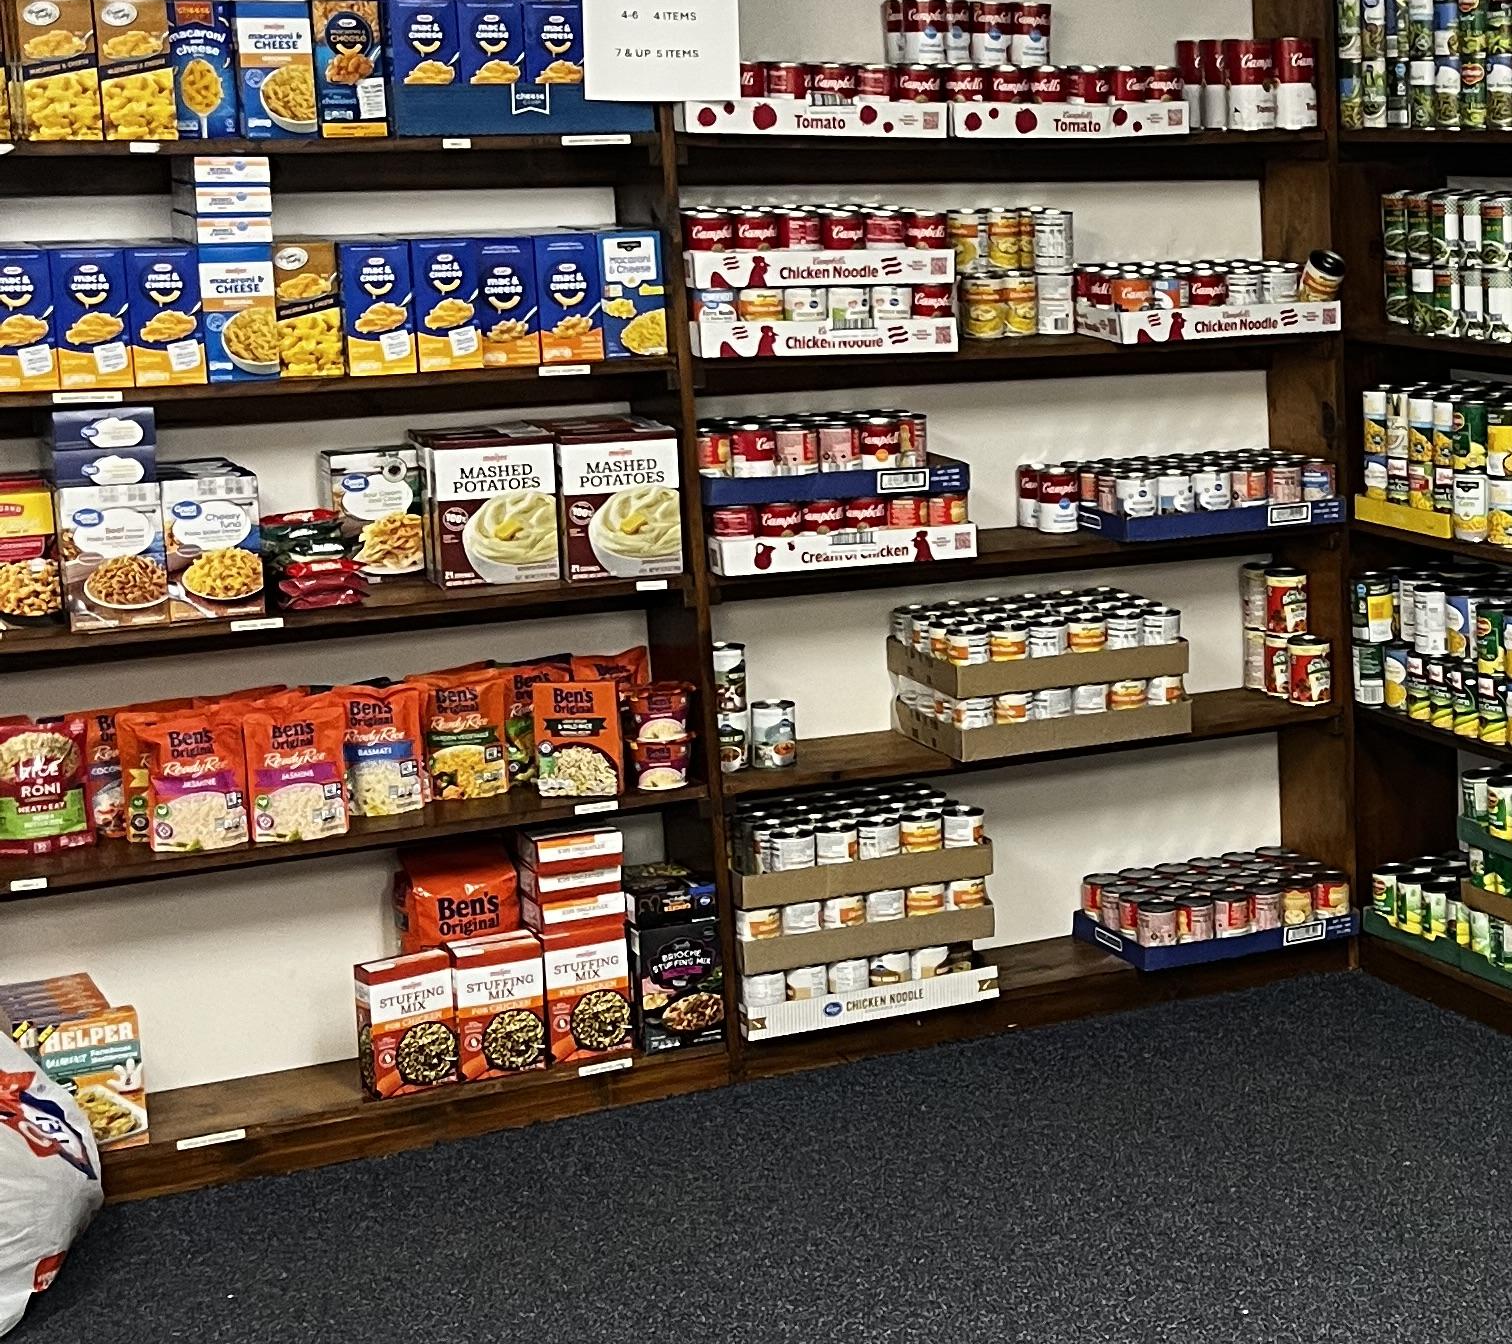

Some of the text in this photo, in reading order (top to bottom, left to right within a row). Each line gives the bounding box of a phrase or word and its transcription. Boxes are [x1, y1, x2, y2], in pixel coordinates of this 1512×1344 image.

[621, 10, 697, 21] 4-6 4 ITEMS
[169, 28, 226, 44] macaroni
[248, 32, 293, 41] macaroni
[409, 31, 442, 40] cheese
[476, 31, 508, 40] cheese
[176, 44, 220, 56] cheese
[254, 39, 299, 50] CHEESE
[615, 48, 699, 58] 7 & UP 5 ITEMS
[795, 114, 845, 130] Tomato
[1054, 119, 1101, 133] Tomato
[780, 266, 878, 280] Chicken Noodle
[216, 284, 261, 293] CHEESE
[1195, 317, 1278, 333] Chicken Noodle
[786, 336, 835, 350] Chicken
[460, 463, 533, 479] MASHED
[586, 458, 657, 474] MASHED
[453, 477, 541, 493] POTATOES
[580, 471, 665, 488] POTATOES
[205, 512, 241, 523] Cheesy
[220, 520, 242, 529] Tuna
[436, 687, 478, 705] Ben's
[553, 688, 593, 704] Ben's
[350, 700, 393, 717] Ben's
[553, 701, 594, 714] Original
[168, 728, 213, 747] Ben's
[271, 720, 314, 739] Ben's
[20, 783, 61, 798] RONI
[438, 892, 499, 921] Ben's
[438, 914, 499, 936] Original
[554, 956, 619, 976] STUFFING
[576, 970, 600, 982] MIX
[466, 974, 534, 995] STUFFING
[380, 985, 444, 1009] STUFFING
[489, 988, 514, 999] MIX
[846, 988, 924, 1012] CHICKEN NOODLE
[401, 999, 426, 1015] MIX
